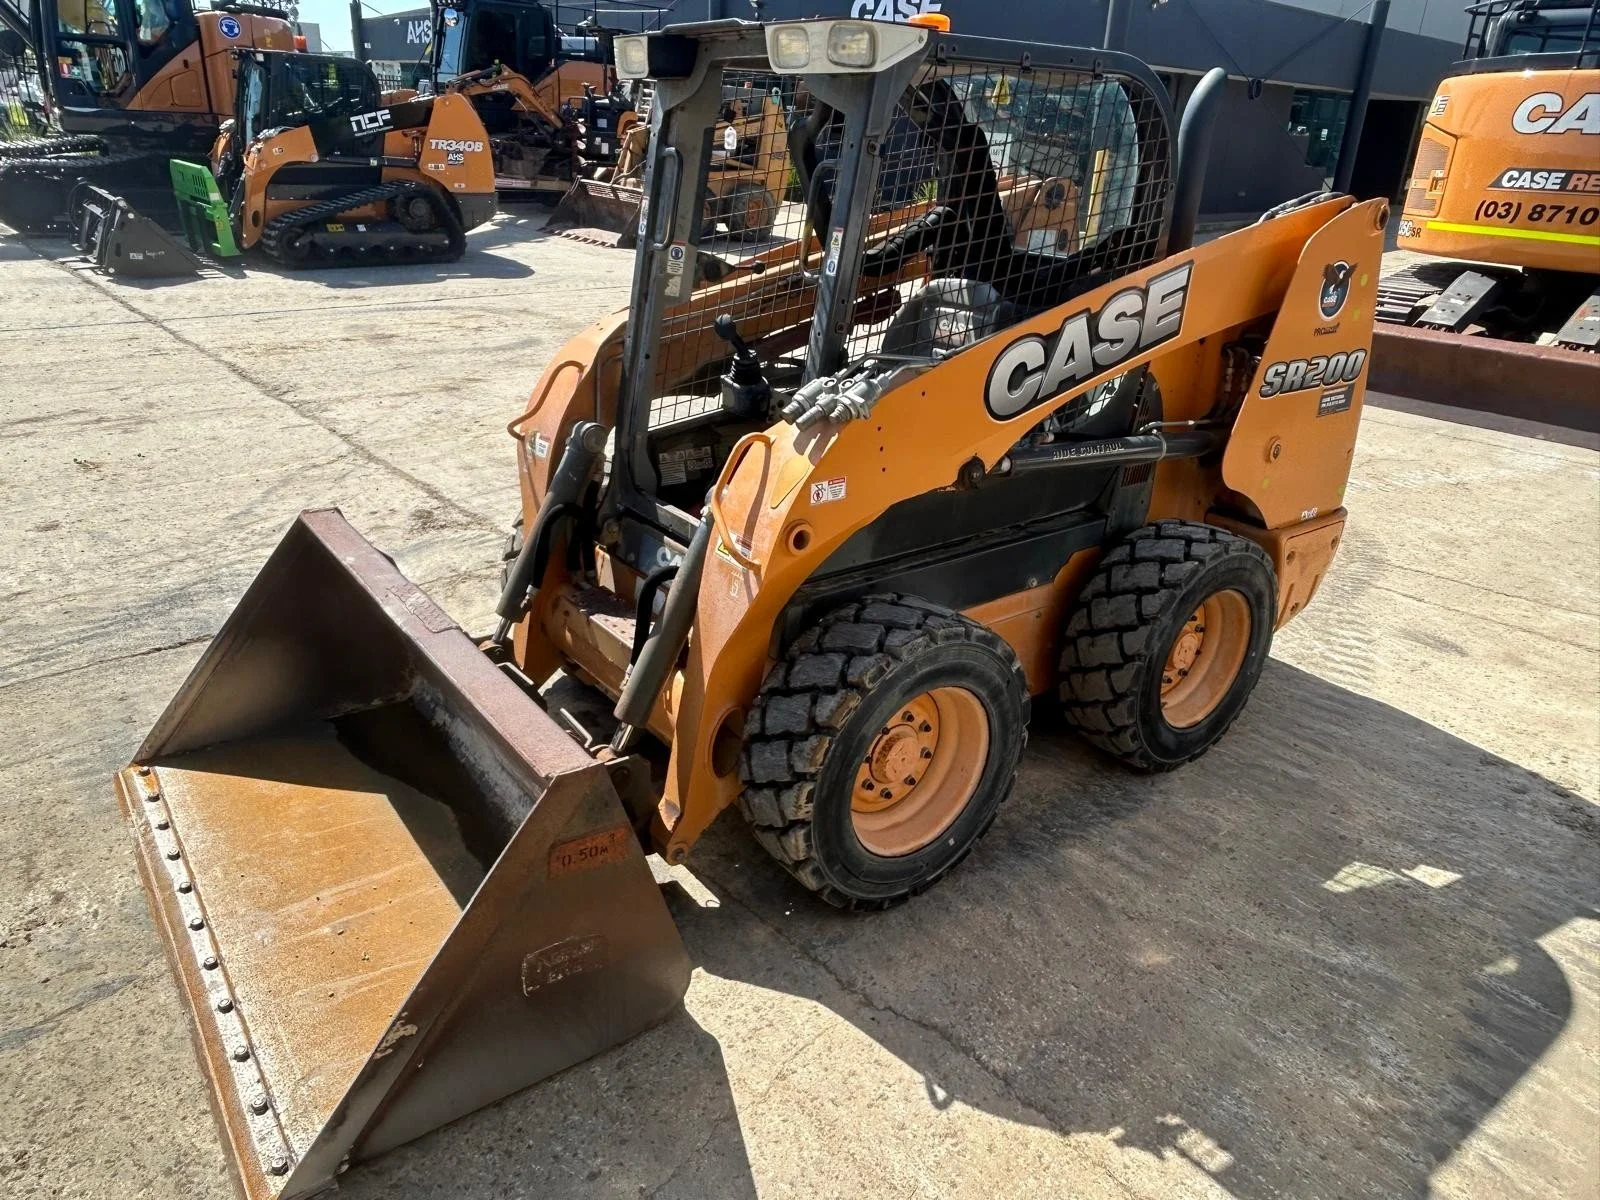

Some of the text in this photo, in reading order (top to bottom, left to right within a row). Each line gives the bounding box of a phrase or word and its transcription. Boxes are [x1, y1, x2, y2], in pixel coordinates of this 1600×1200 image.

[406, 19, 432, 44] AHS
[429, 139, 484, 152] TR340B
[1501, 170, 1567, 190] CASE
[1474, 199, 1600, 226] (03) 8710
[984, 262, 1193, 418] CASE
[1259, 349, 1367, 398] SR200
